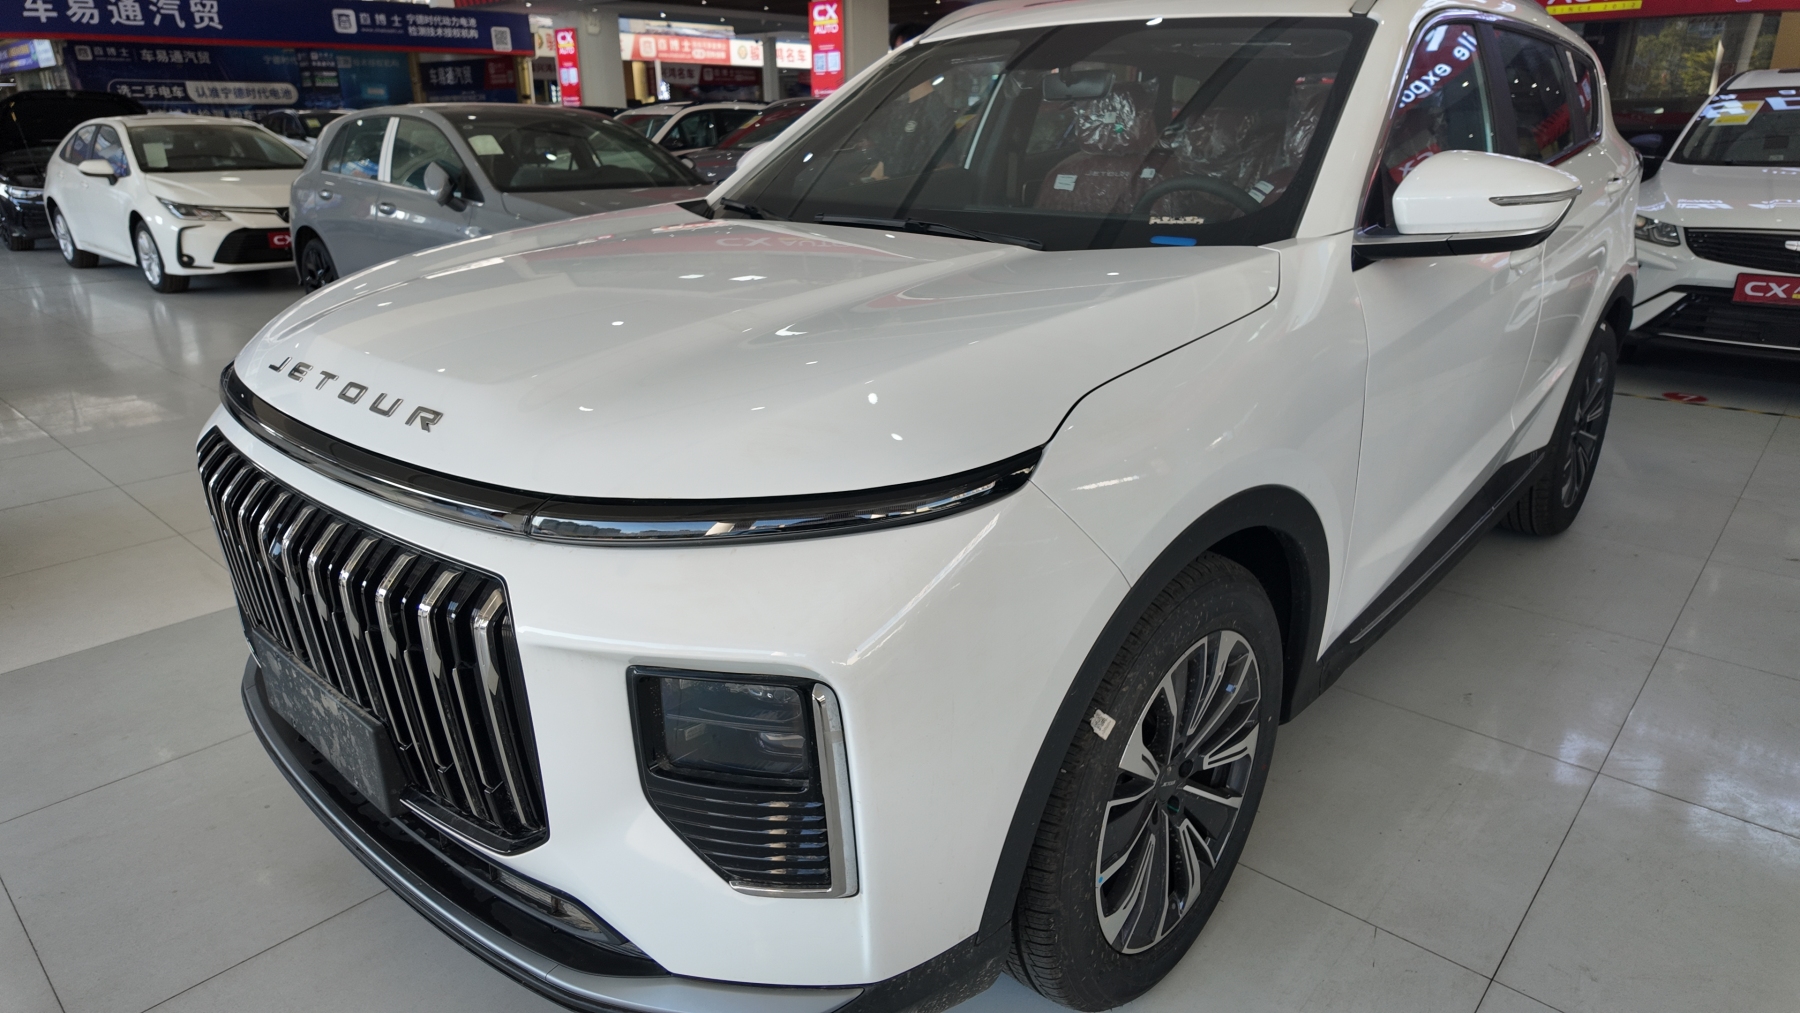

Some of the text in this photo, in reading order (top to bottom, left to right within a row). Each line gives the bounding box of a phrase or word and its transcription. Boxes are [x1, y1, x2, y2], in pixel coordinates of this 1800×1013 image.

[22, 0, 224, 30] 车易通汽贸
[812, 3, 839, 20] CX
[556, 31, 574, 44] CX
[813, 24, 840, 35] AUTO
[139, 49, 212, 64] 车易通汽贸
[1744, 281, 1791, 299] CX
[269, 357, 444, 433] JETOUR
